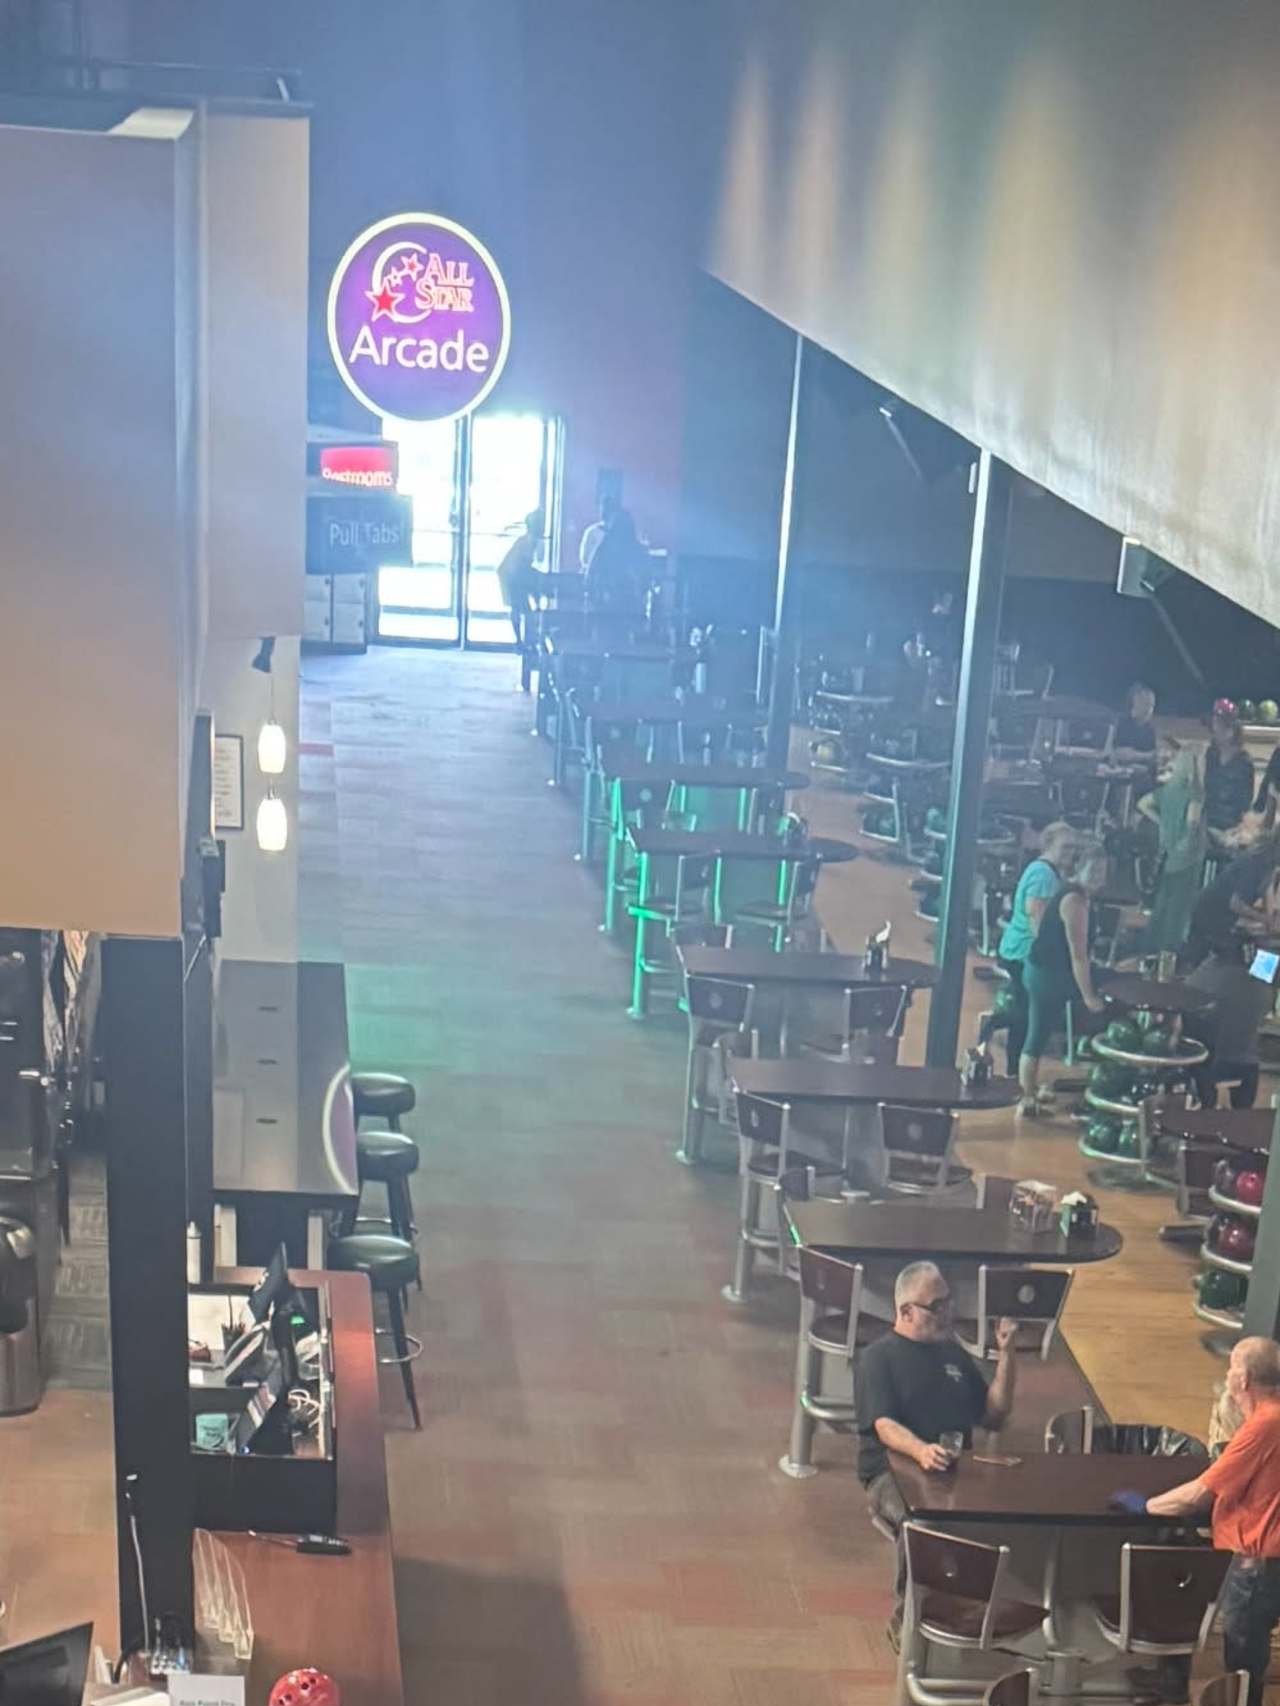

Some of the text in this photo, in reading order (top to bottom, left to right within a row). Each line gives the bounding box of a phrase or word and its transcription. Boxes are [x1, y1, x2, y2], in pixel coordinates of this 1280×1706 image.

[422, 253, 475, 288] ALL
[414, 278, 475, 313] STAR
[349, 325, 490, 373] Arcade
